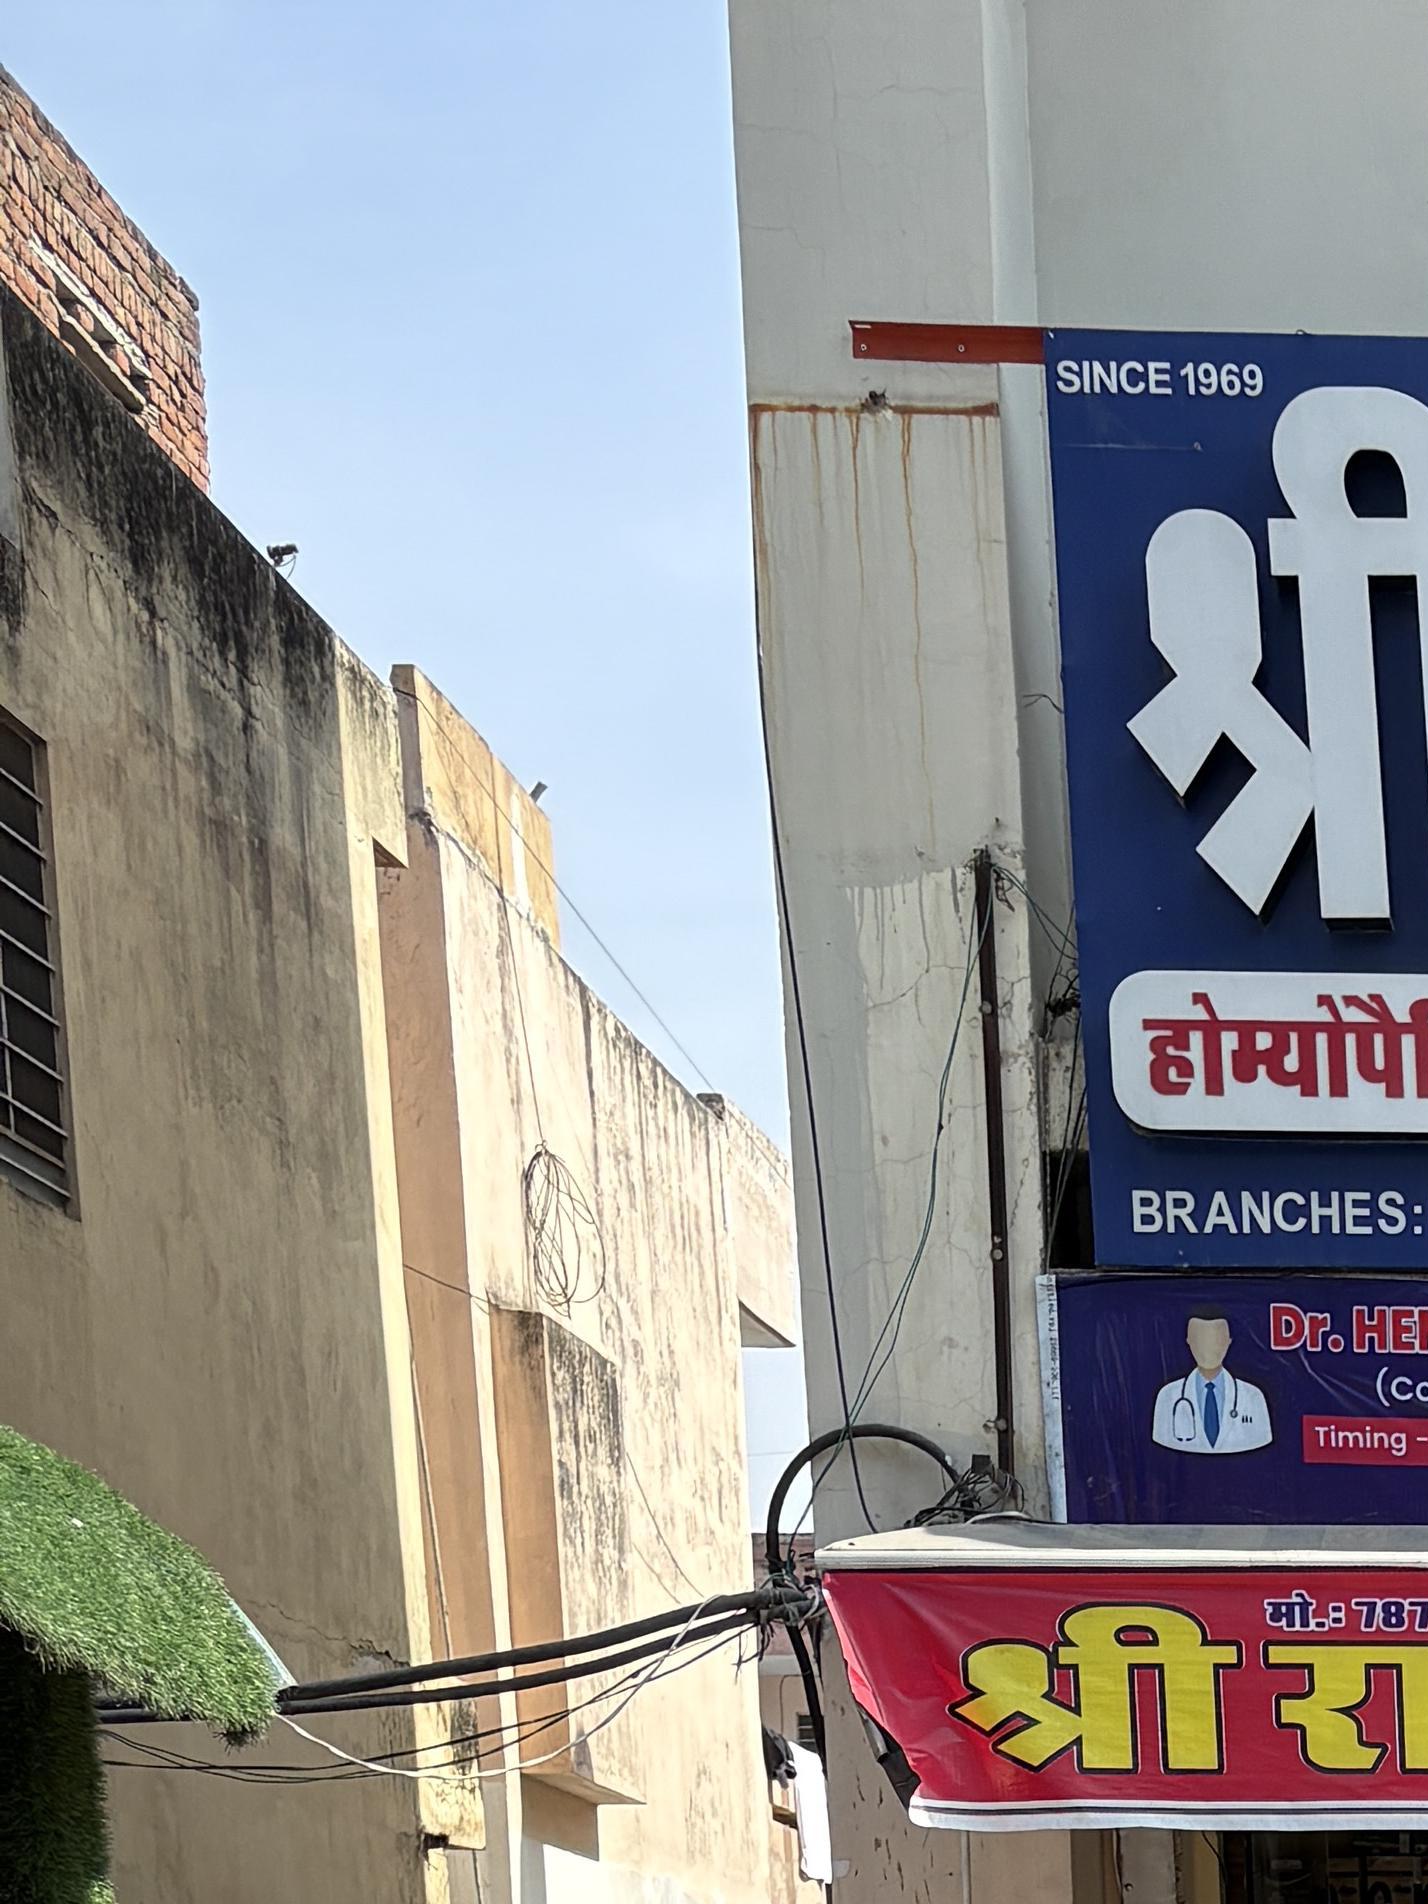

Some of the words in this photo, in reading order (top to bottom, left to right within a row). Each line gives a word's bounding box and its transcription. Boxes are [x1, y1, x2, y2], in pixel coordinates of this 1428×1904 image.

[1056, 361, 1172, 396] SINCE
[1180, 364, 1264, 397] 1969
[1269, 1303, 1344, 1354] Dr.
[1314, 1425, 1407, 1455] Timing
[946, 1599, 1245, 1776] श्री
